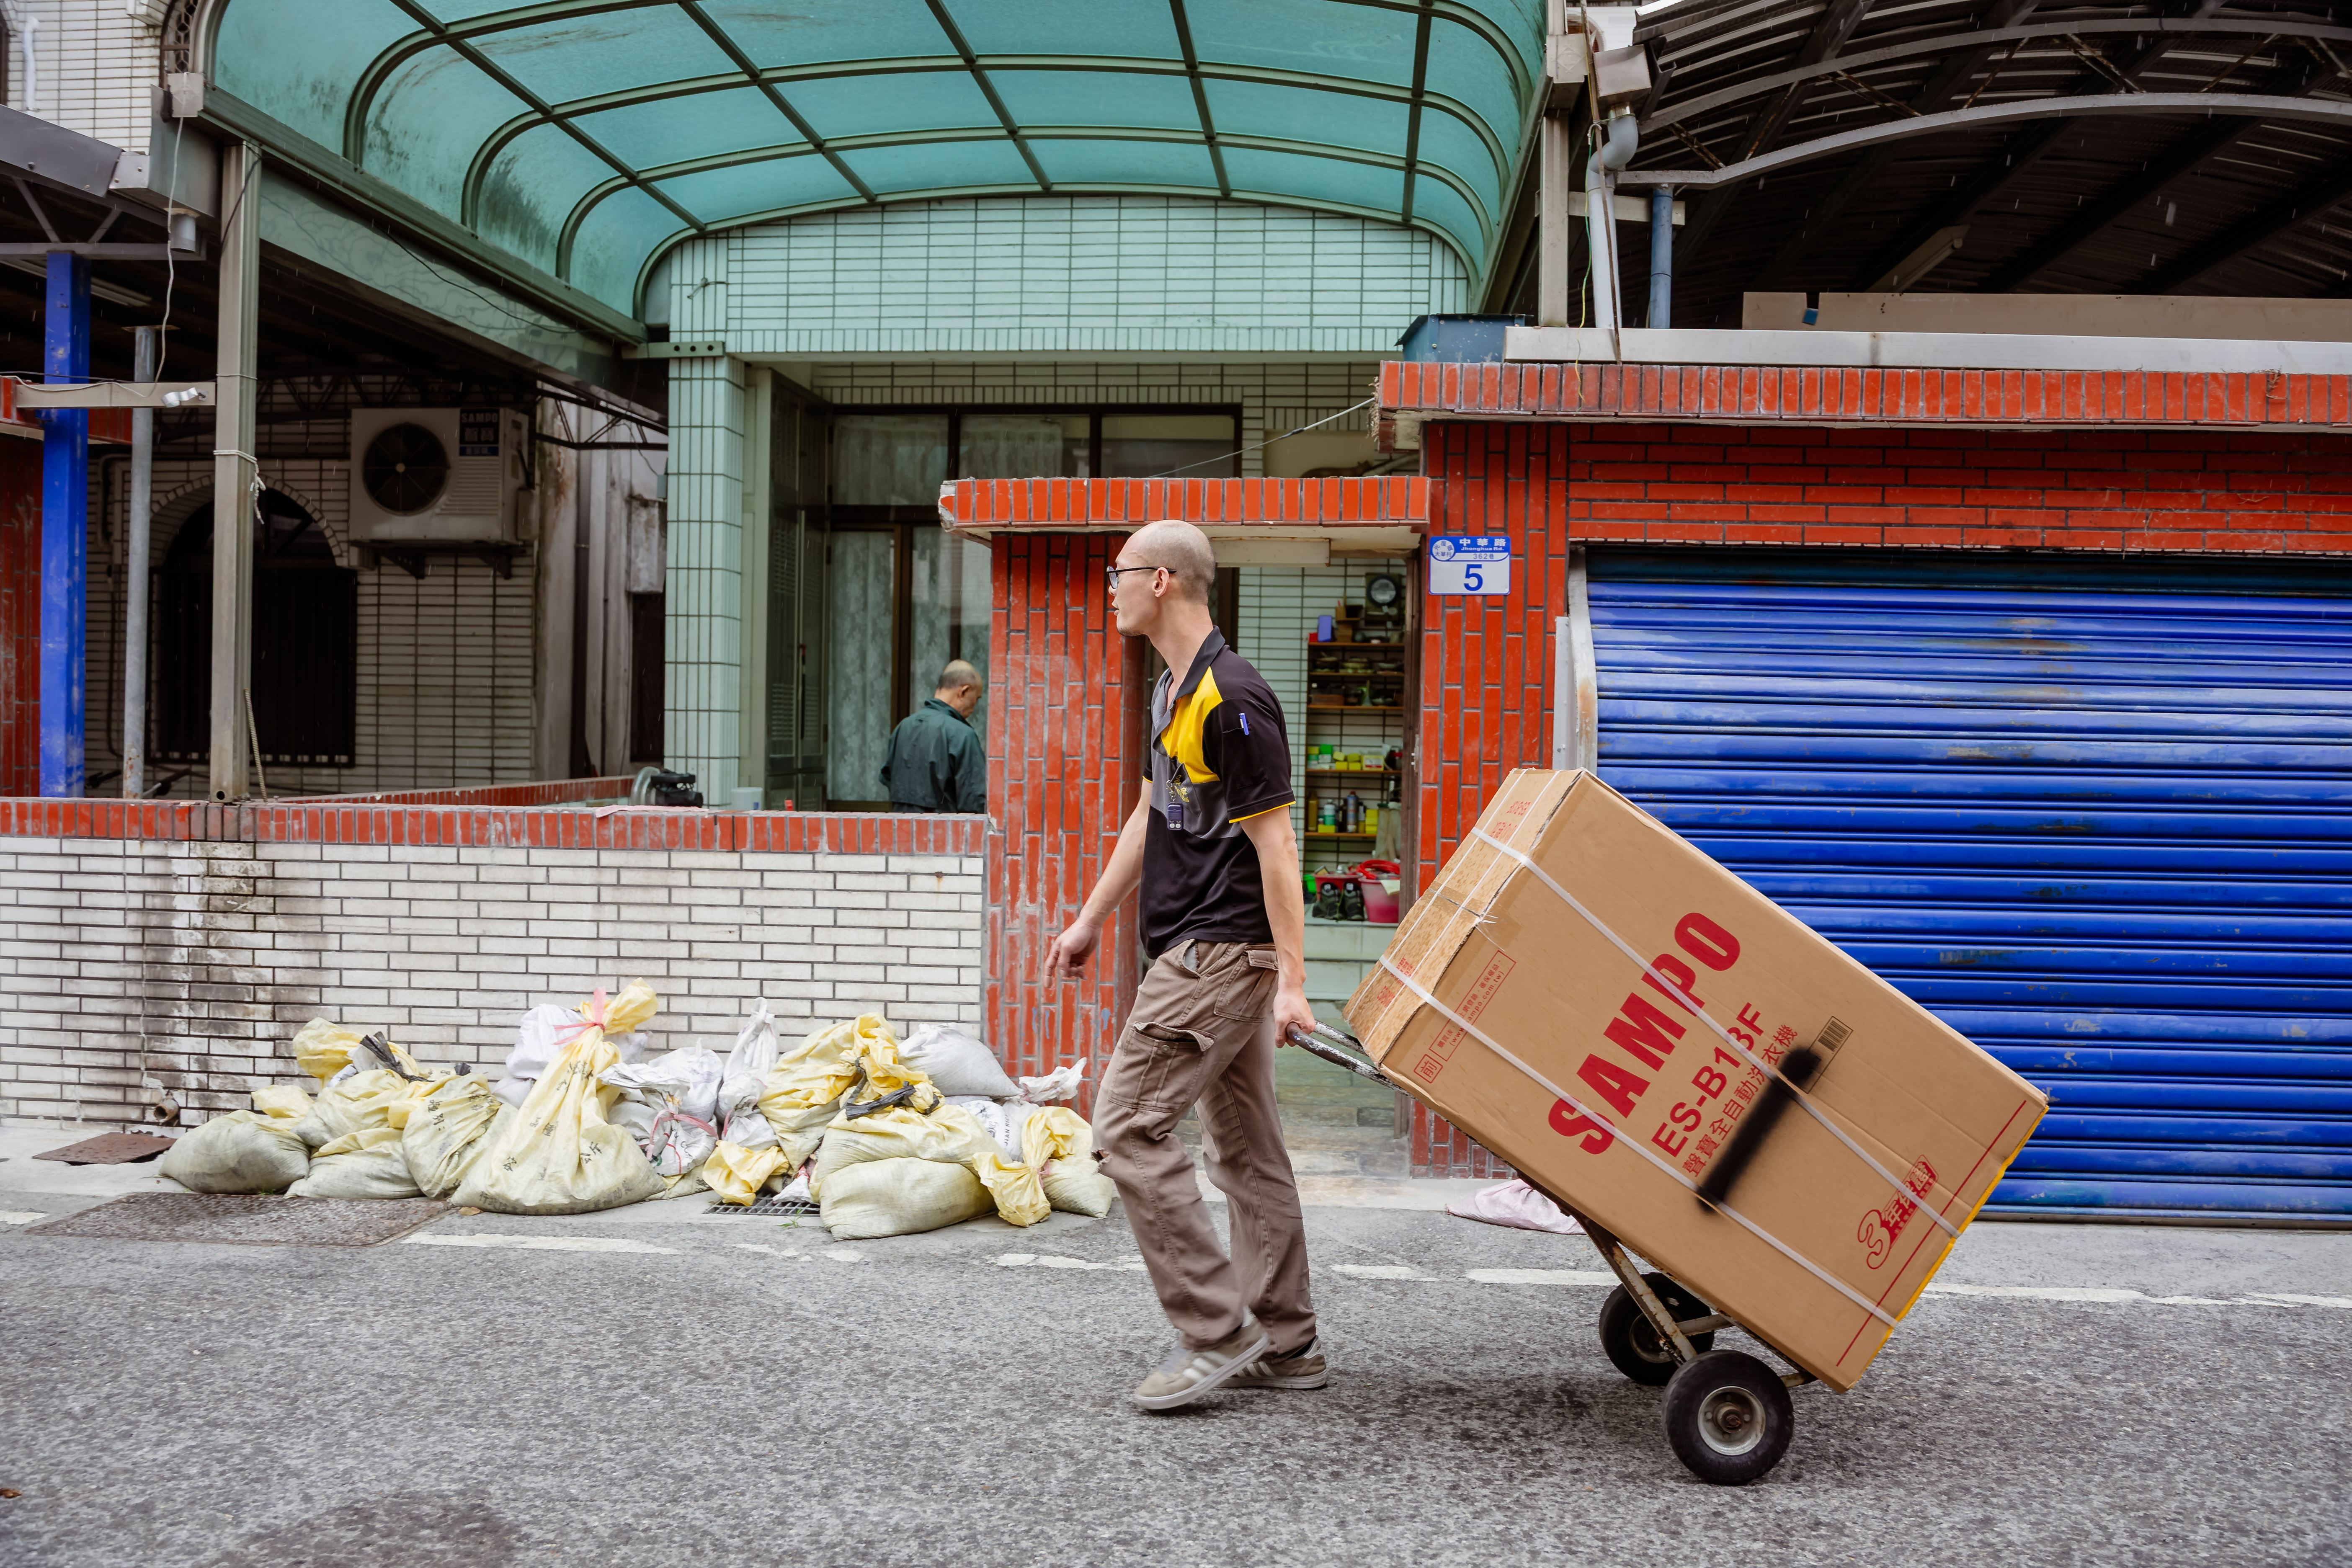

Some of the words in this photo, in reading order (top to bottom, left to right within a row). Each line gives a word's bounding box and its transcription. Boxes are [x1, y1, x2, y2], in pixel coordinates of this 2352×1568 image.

[462, 413, 498, 423] SAMPO
[1464, 564, 1483, 591] 5
[1420, 1060, 1438, 1078] 前
[1548, 912, 1740, 1155] SAMPO
[1651, 1002, 1764, 1158] ES-B13F
[1682, 1024, 1798, 1177] 聲寶全自動洗衣機
